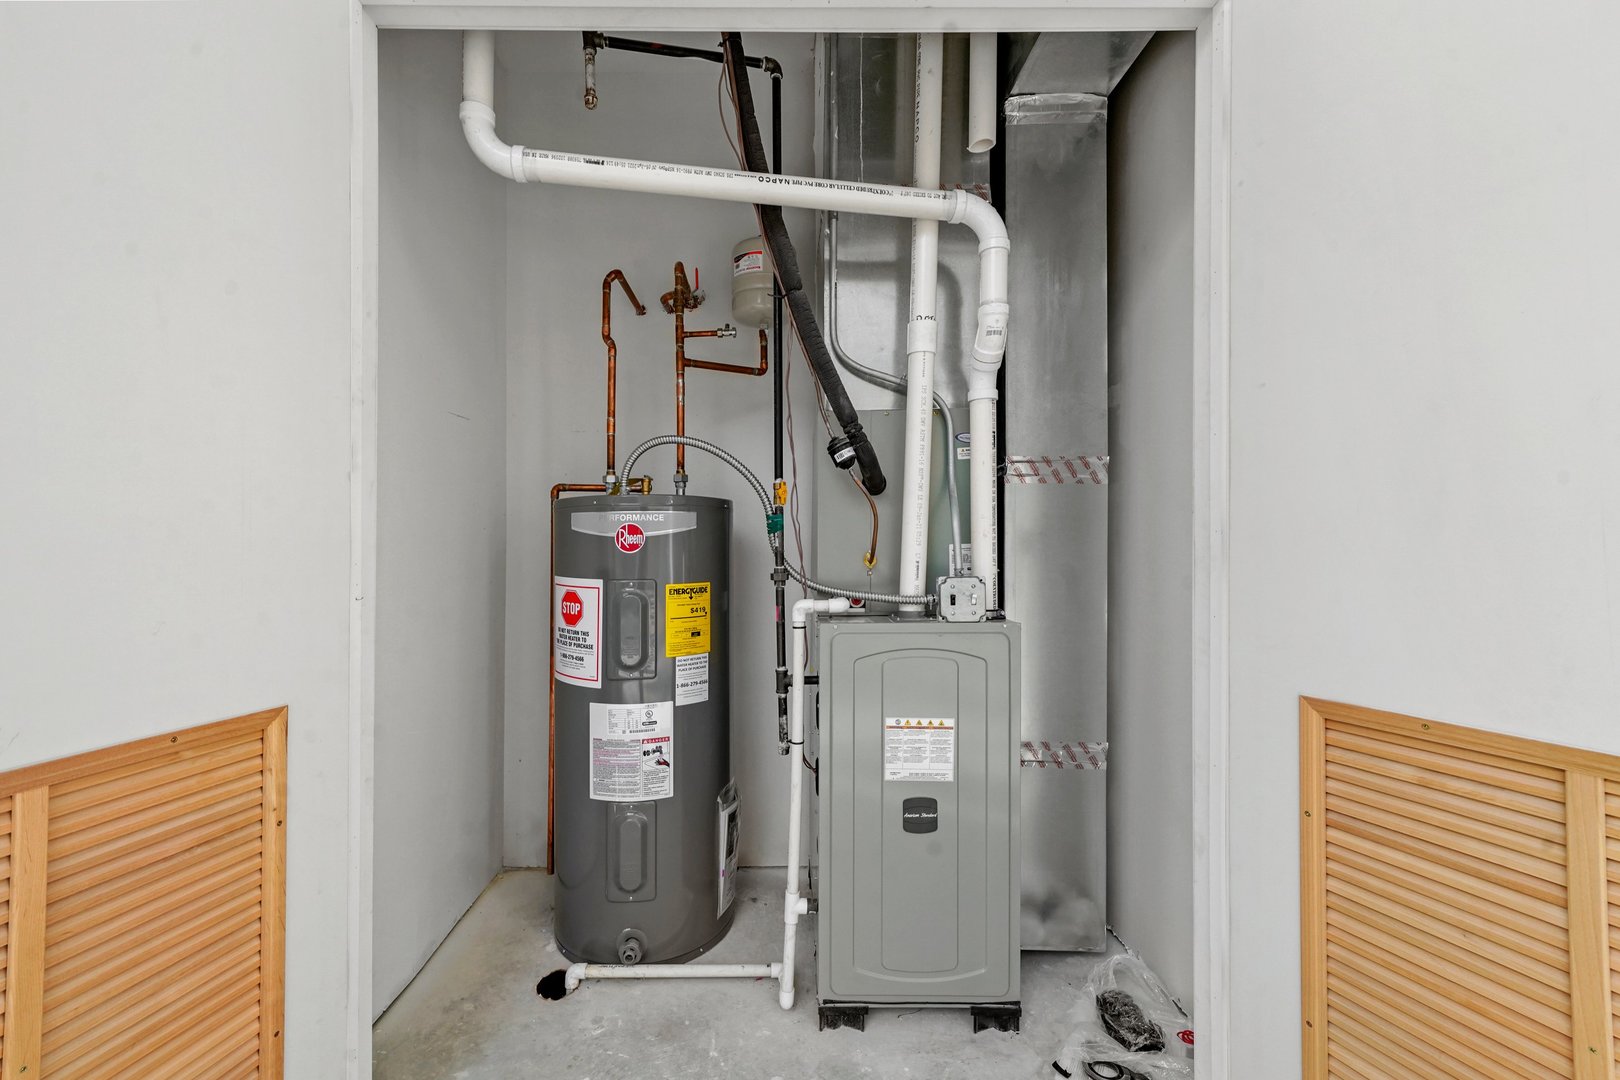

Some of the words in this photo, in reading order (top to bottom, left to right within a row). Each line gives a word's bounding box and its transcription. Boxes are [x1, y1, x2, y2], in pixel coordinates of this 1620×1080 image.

[758, 175, 790, 185] NAPCO
[829, 183, 855, 191] CELLULAR
[618, 523, 644, 548] Rheem
[563, 602, 580, 615] STOP
[573, 642, 593, 650] PURCHASE
